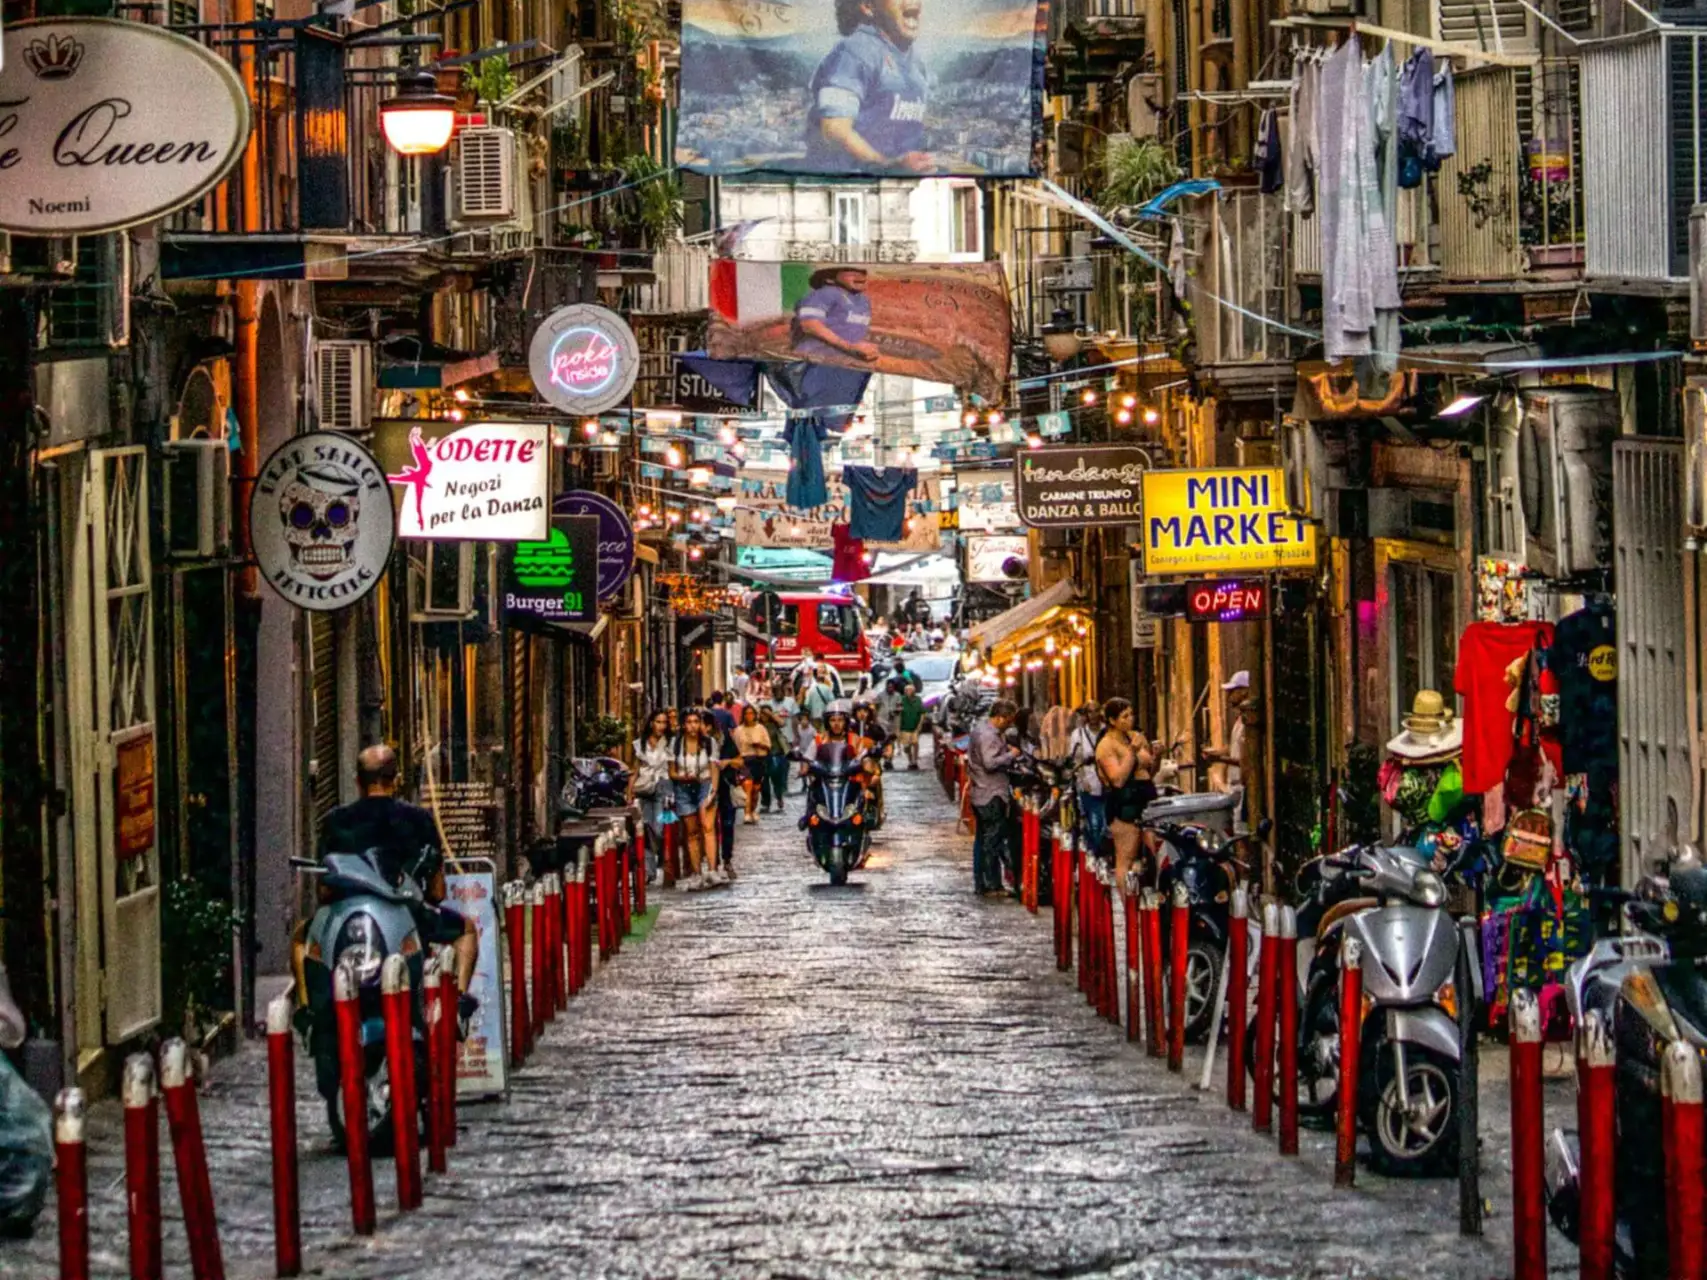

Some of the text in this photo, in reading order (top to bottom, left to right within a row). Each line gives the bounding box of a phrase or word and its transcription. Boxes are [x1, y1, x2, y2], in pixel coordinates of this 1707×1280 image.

[53, 97, 217, 167] Queen
[29, 196, 91, 215] Noemi
[260, 445, 381, 494] DEAD SAILOR
[444, 474, 502, 498] Negozi
[1040, 491, 1086, 501] CARMINE
[1187, 474, 1270, 509] MINI
[430, 496, 543, 529] per la Danza
[1027, 504, 1080, 519] DANZA
[1083, 503, 1096, 517] &
[1150, 512, 1305, 548] MARKET
[273, 568, 374, 601] TATTOOING
[506, 591, 584, 613] Burger91
[1194, 589, 1261, 611] OPEN
